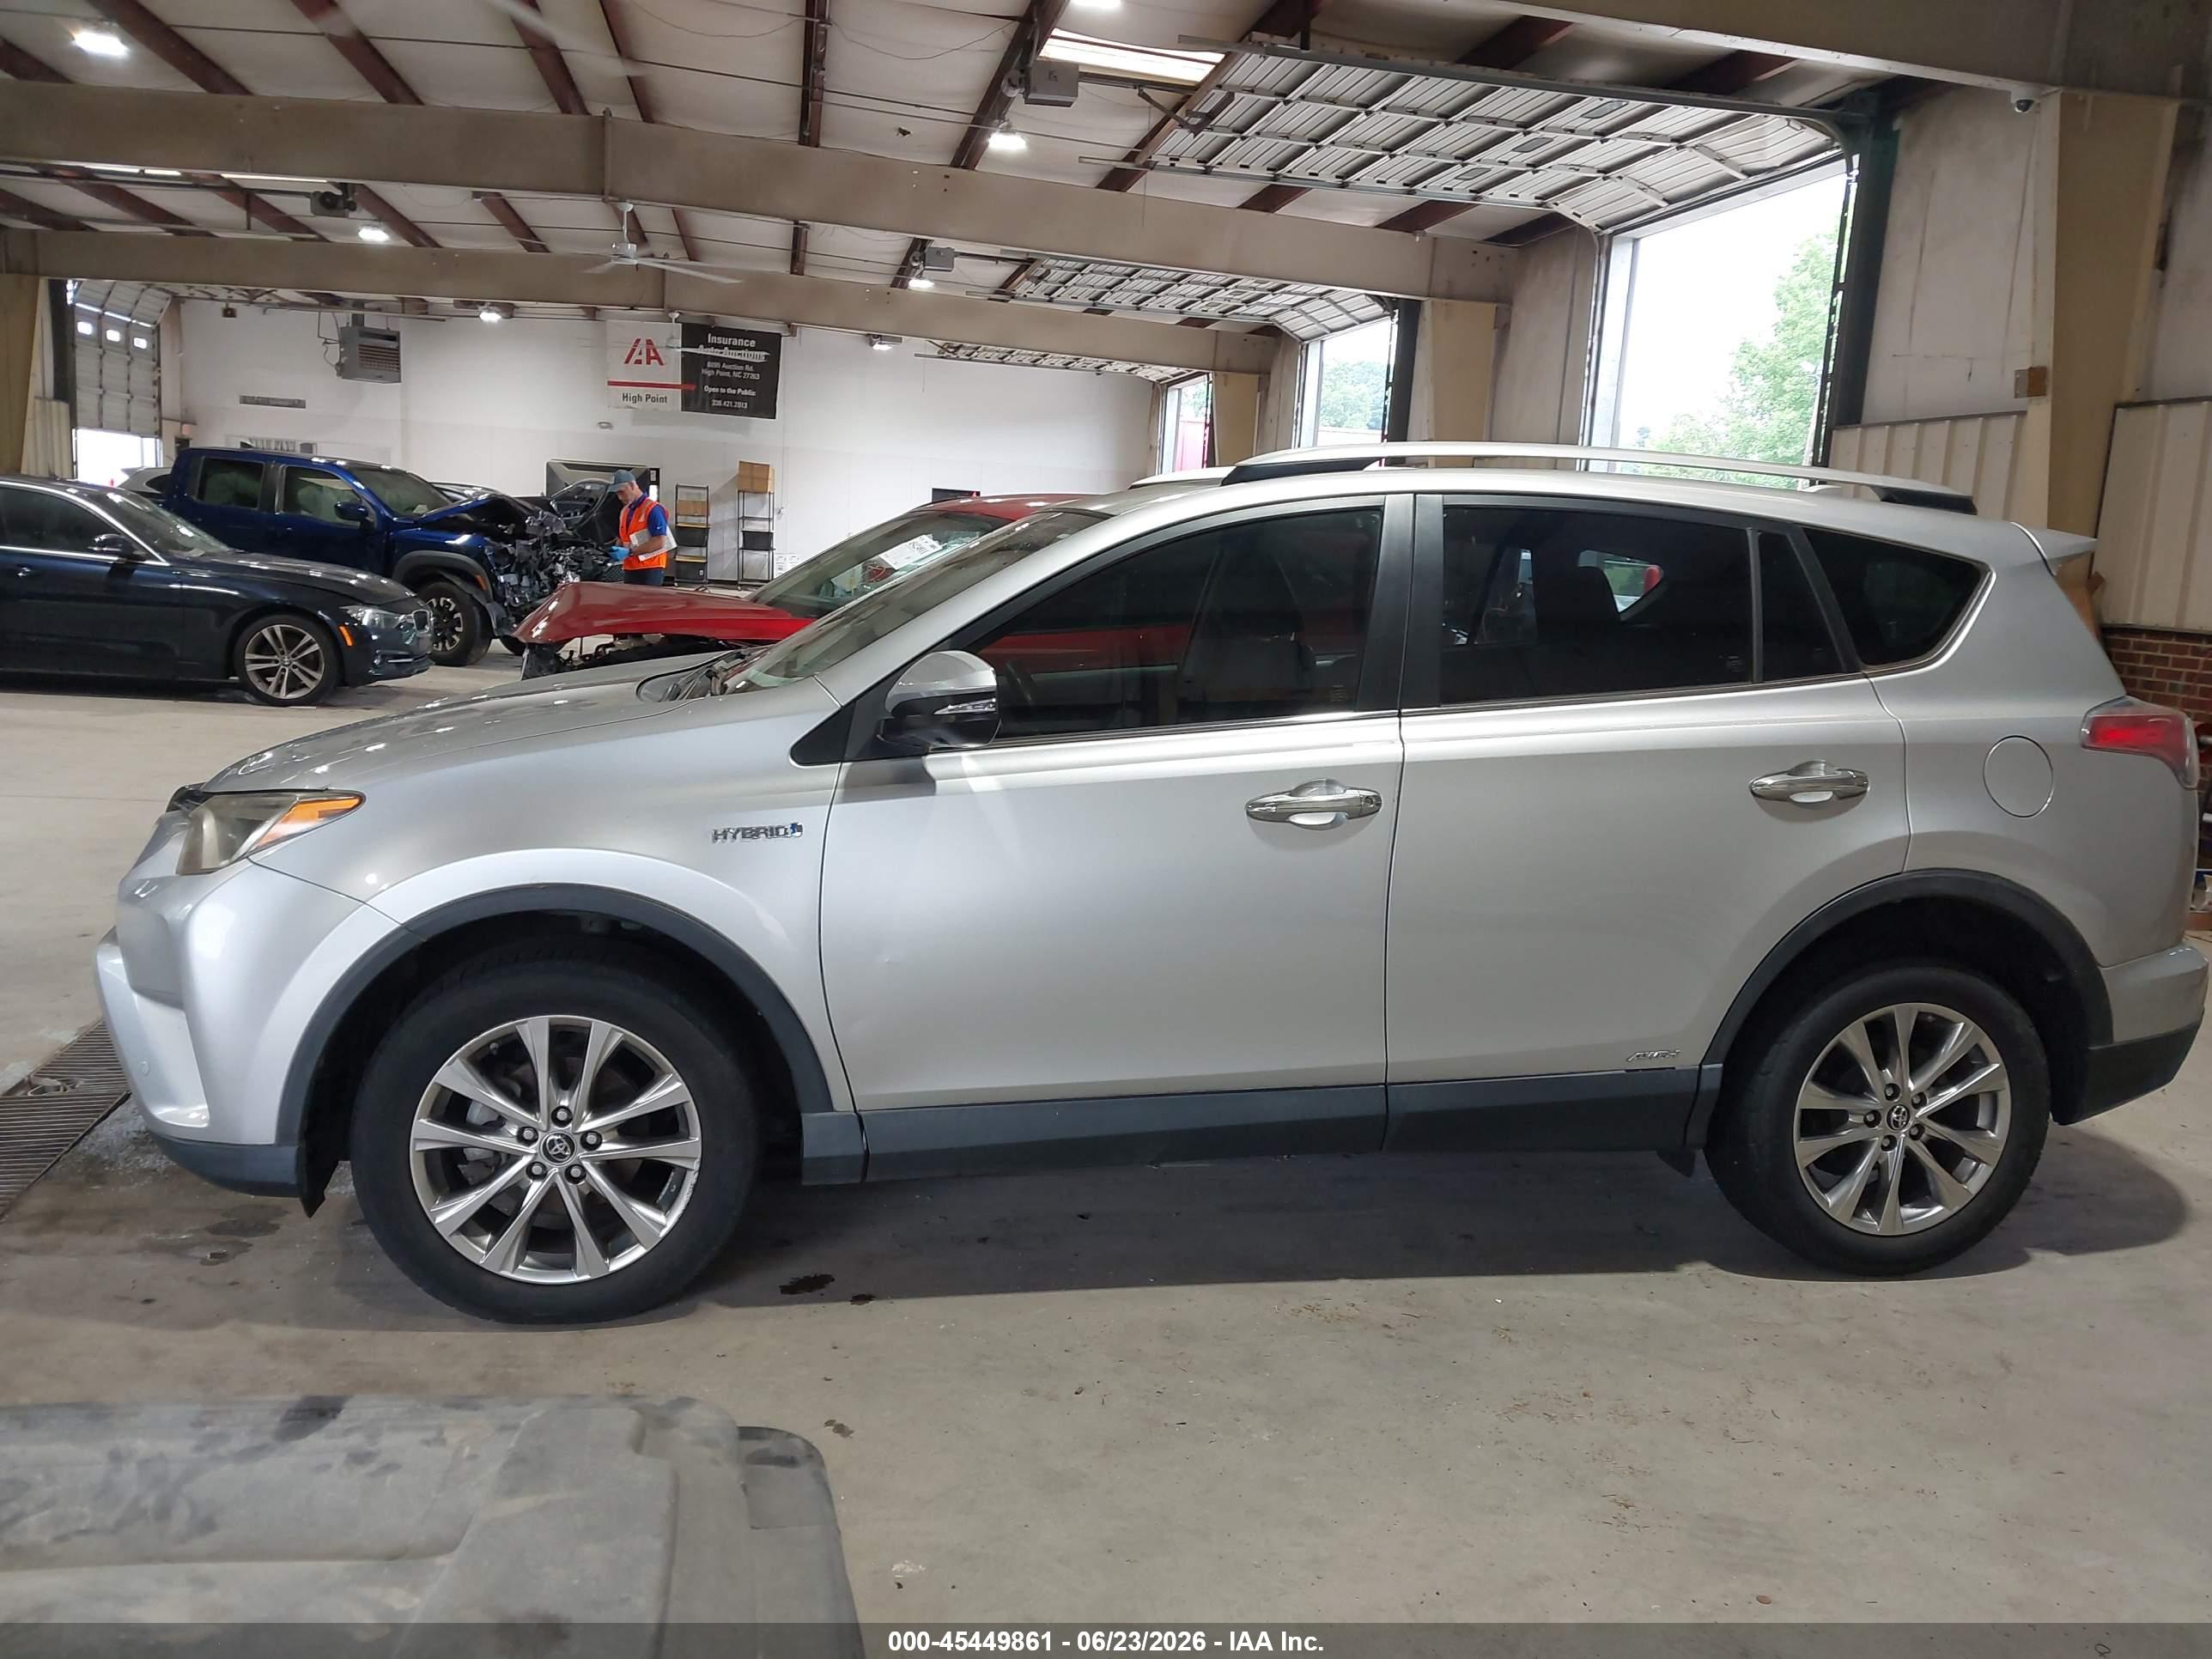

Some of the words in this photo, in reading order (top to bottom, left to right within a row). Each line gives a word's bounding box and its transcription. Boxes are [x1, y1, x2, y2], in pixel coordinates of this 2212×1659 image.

[708, 333, 757, 348] Insurance
[703, 385, 720, 393] Open
[737, 388, 757, 397] Public
[622, 392, 643, 404] High
[645, 393, 668, 404] Point
[712, 825, 789, 842] HYBRID
